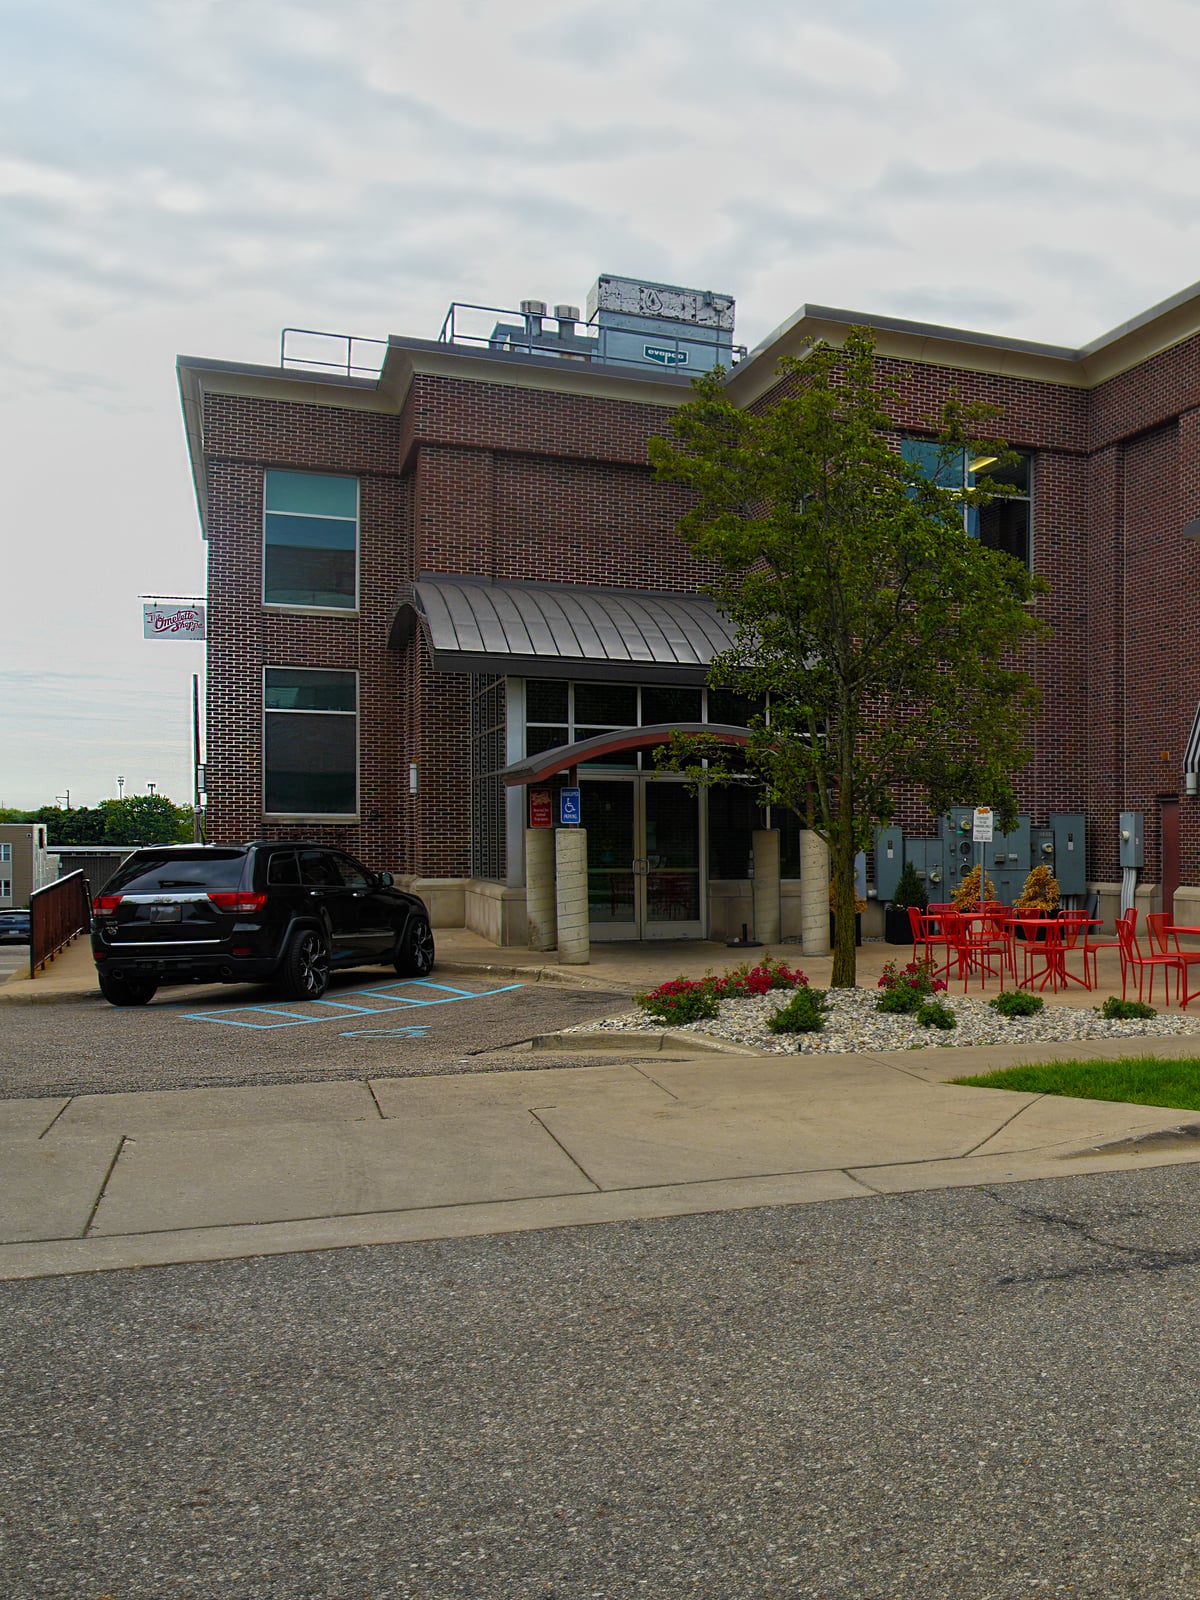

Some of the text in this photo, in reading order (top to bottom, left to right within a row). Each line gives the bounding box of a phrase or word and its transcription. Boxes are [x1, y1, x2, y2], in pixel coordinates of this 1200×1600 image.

[648, 349, 684, 361] evapco
[152, 610, 199, 633] Omelette
[171, 620, 204, 632] Shoppe
